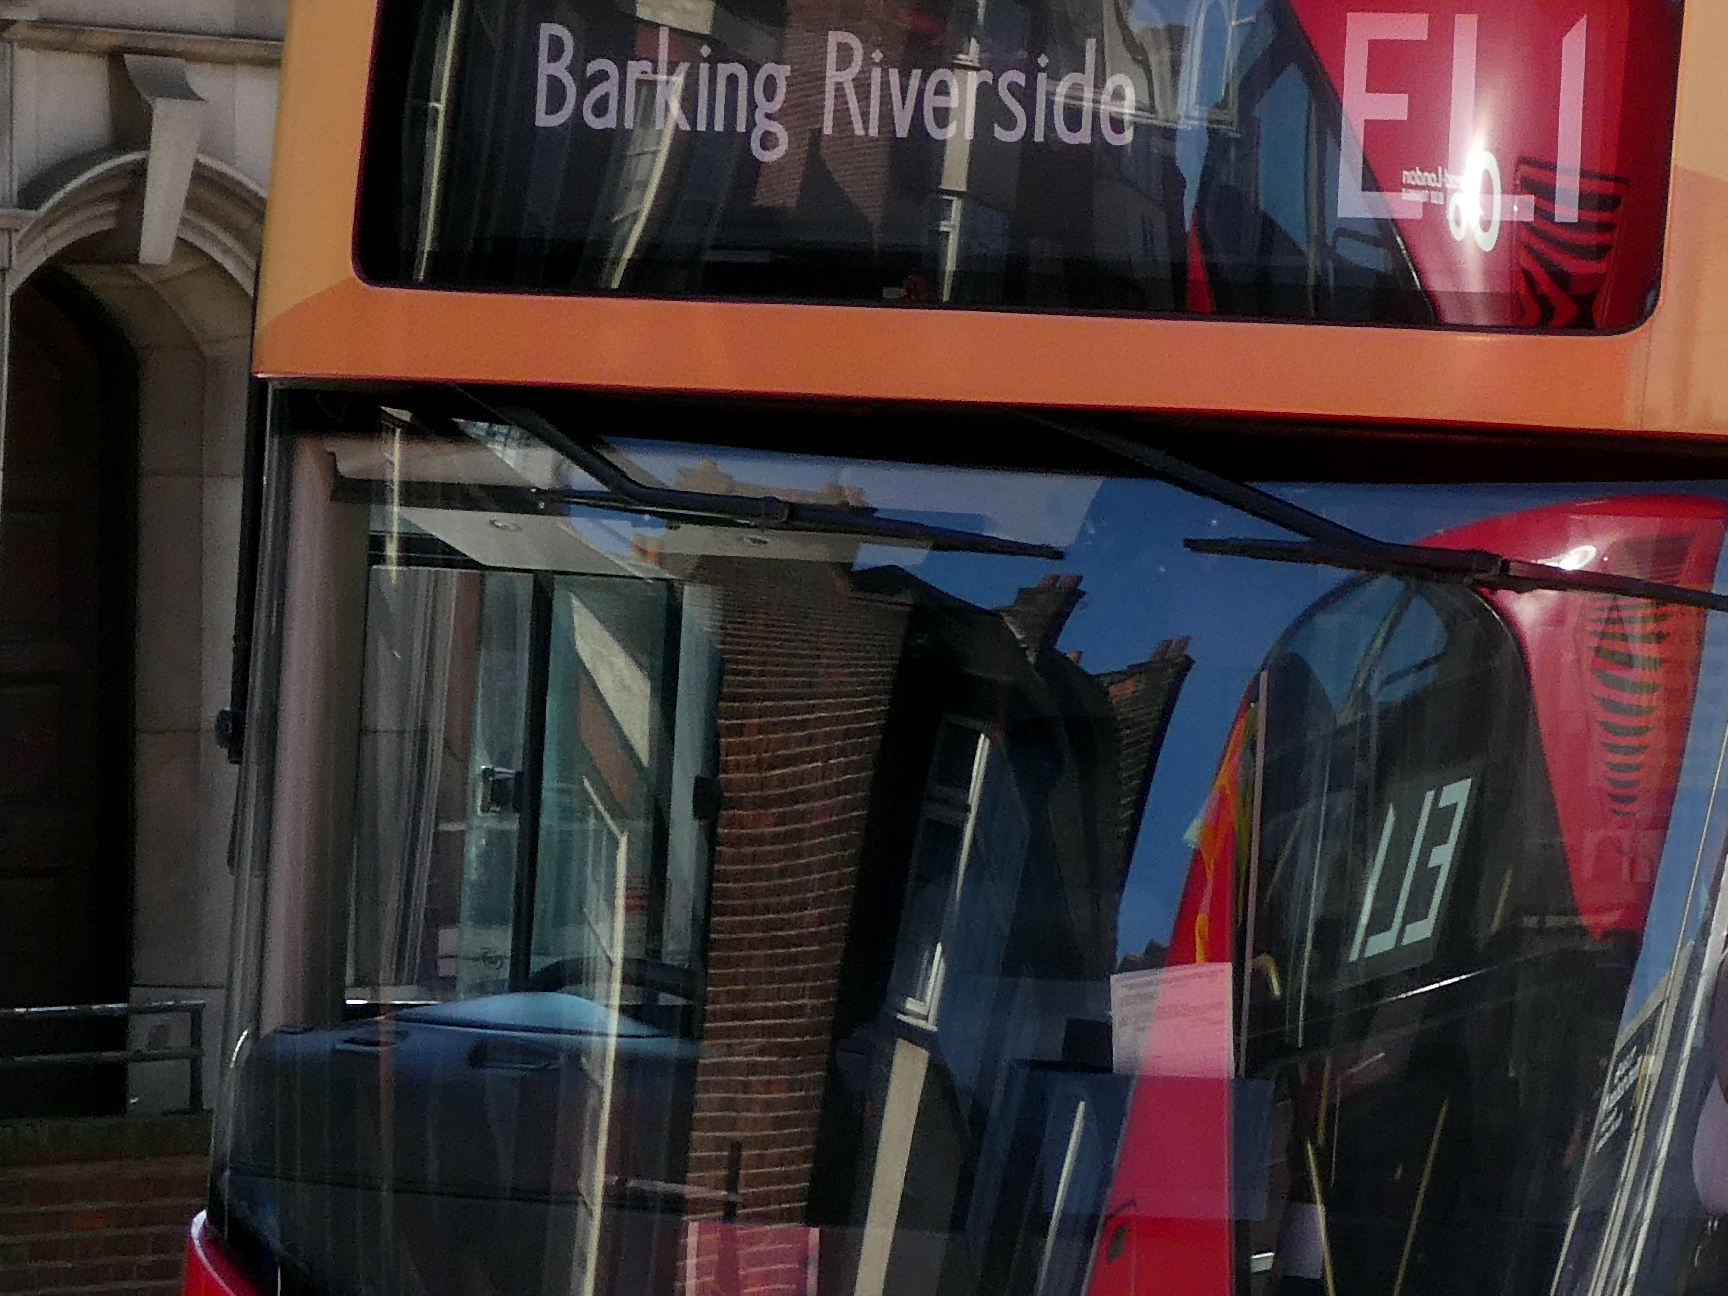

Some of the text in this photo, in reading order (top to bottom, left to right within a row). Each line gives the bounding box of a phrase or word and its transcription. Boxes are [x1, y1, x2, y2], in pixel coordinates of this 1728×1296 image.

[536, 22, 1136, 162] Barking Riverside
[1337, 12, 1587, 222] EL1
